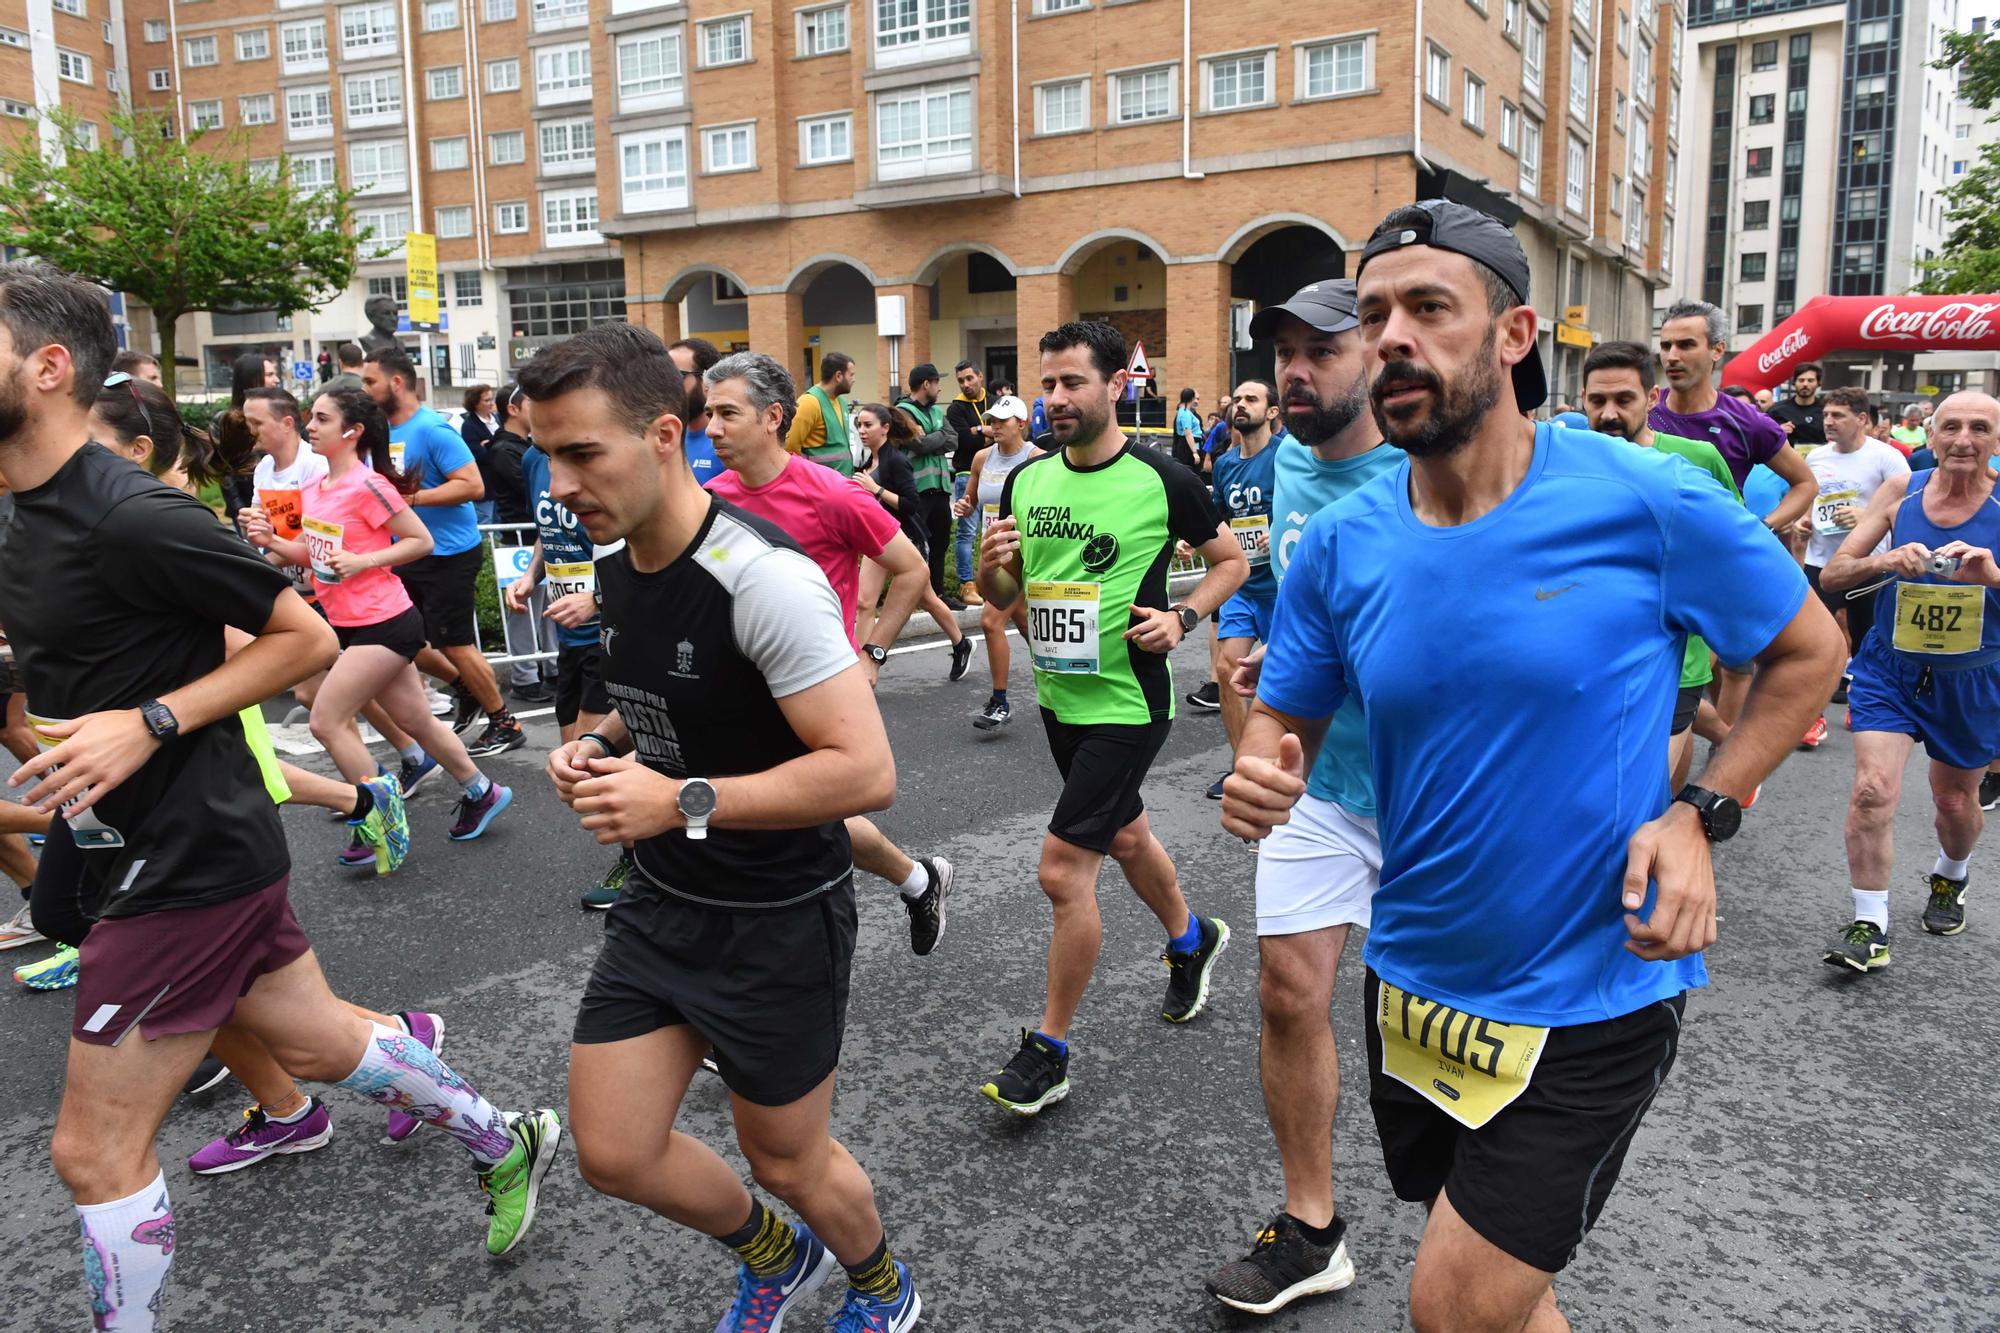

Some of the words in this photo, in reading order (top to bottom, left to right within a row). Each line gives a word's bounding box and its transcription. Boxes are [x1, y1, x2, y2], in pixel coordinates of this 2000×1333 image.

[1027, 506, 1071, 521] MEDIA
[1027, 521, 1094, 540] LARANXA
[1031, 606, 1085, 643] 3065
[1911, 604, 1962, 632] 482
[1438, 1060, 1465, 1081] IVAN
[854, 1297, 870, 1305] NIKE
